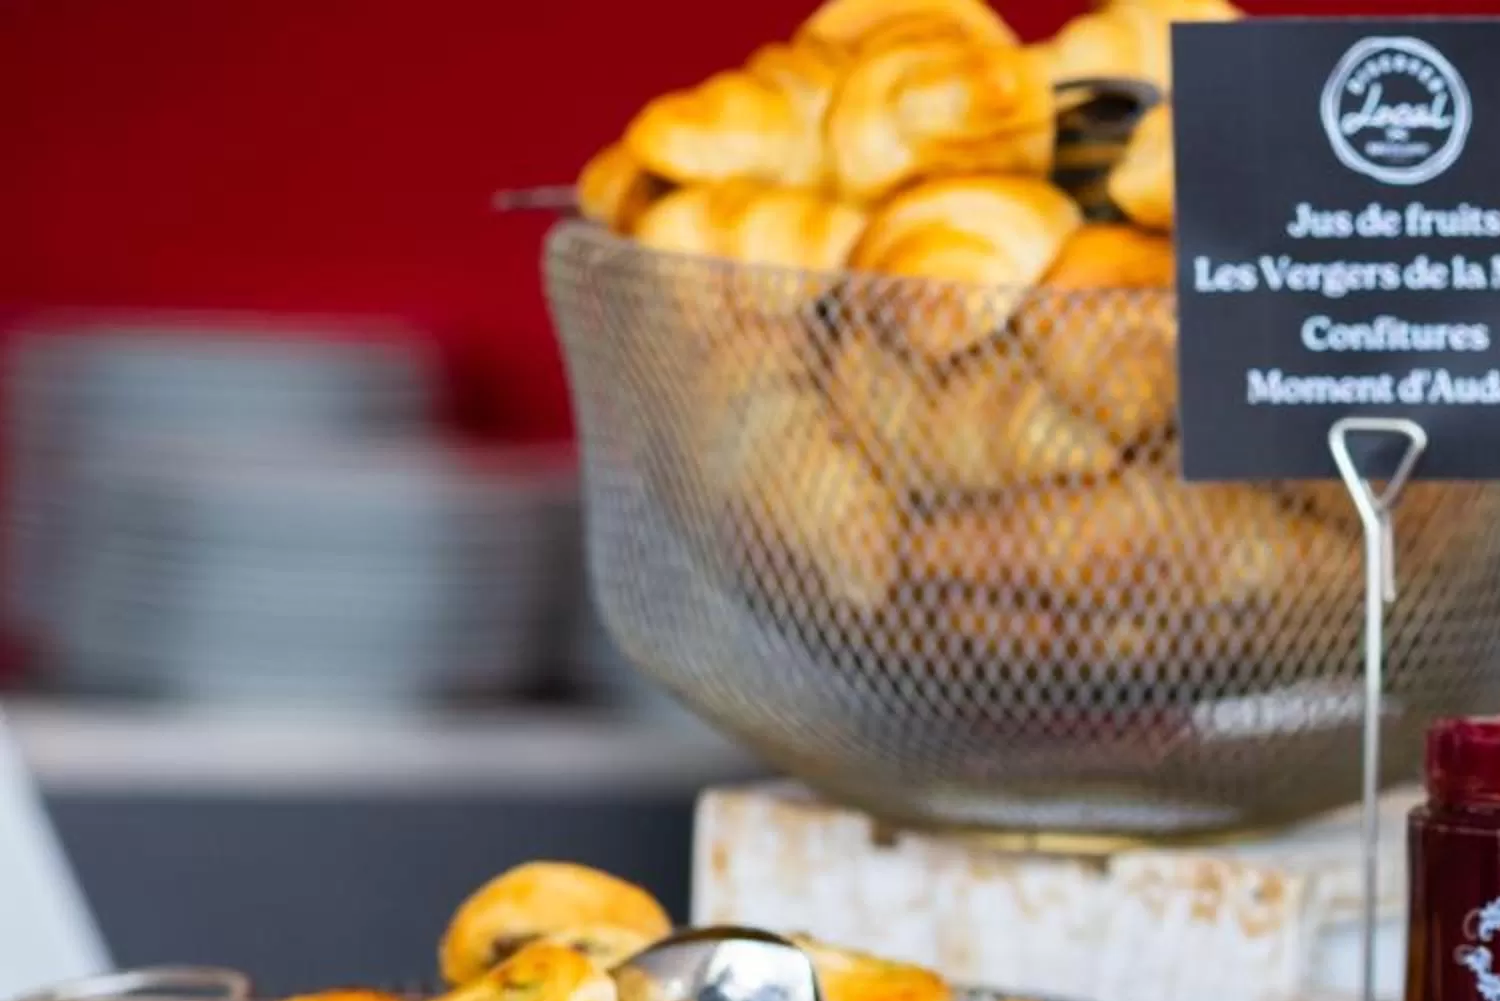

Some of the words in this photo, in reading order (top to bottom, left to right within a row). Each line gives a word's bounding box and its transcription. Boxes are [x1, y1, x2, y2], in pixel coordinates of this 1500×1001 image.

[1287, 202, 1353, 237] Jus
[1356, 203, 1400, 236] de
[1194, 255, 1258, 292] Les
[1259, 255, 1400, 297] Vergers
[1403, 255, 1447, 290] de
[1452, 255, 1486, 289] la
[1301, 315, 1490, 351] Confitures
[1247, 368, 1394, 404] Moment
